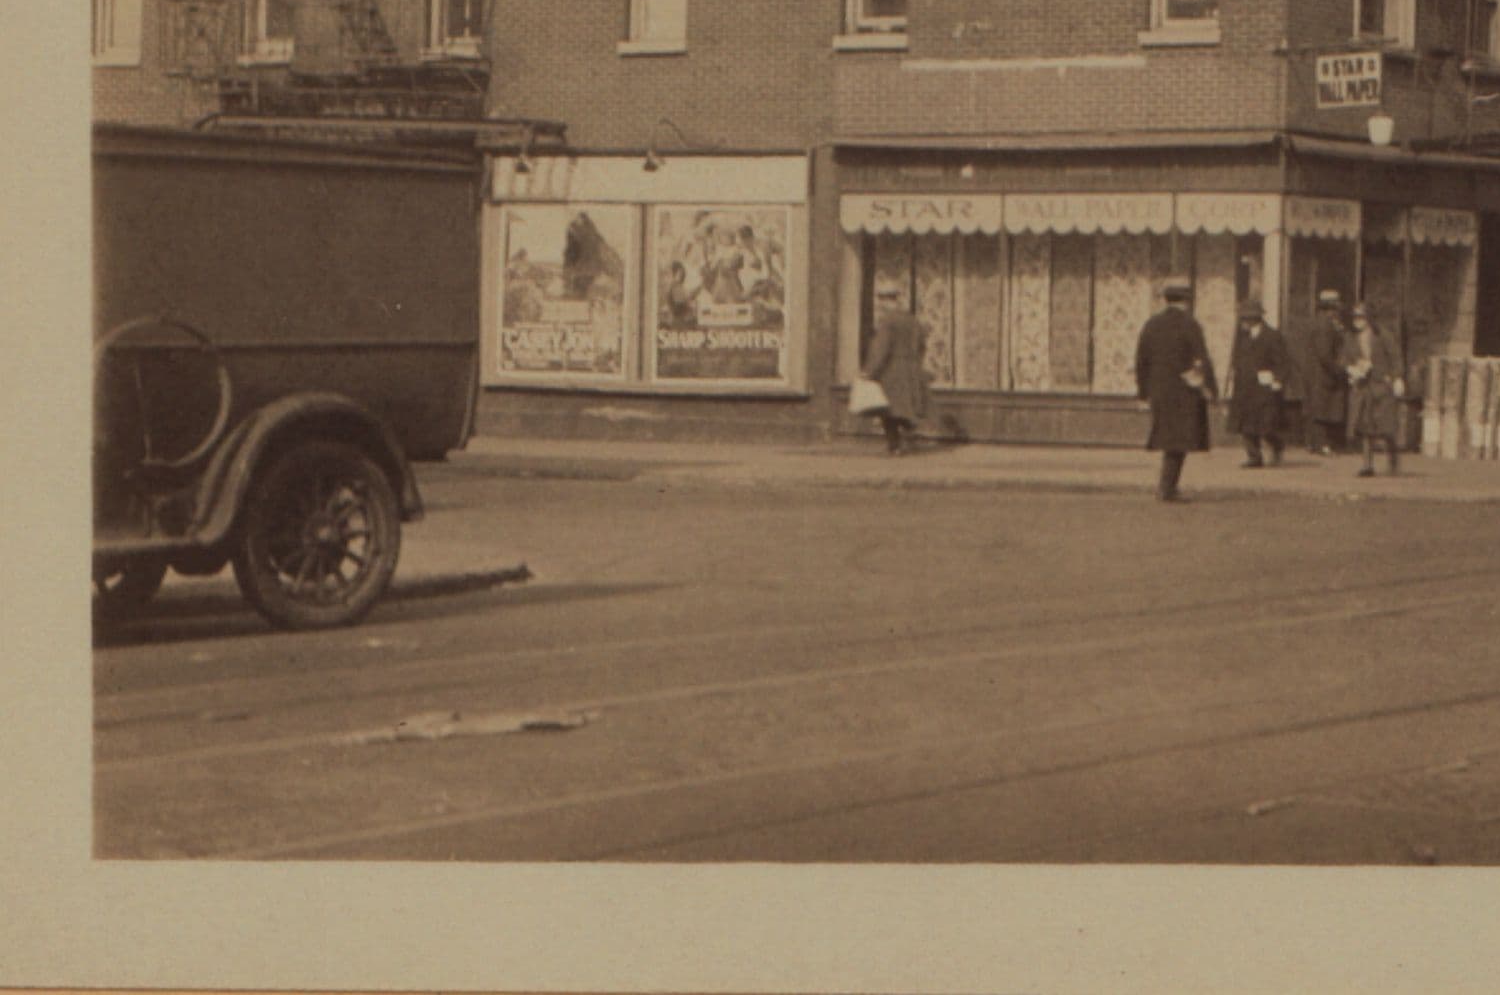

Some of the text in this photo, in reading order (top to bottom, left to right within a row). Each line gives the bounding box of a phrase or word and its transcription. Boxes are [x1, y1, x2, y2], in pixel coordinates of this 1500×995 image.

[1332, 56, 1365, 76] STAR
[1319, 76, 1380, 103] WALL PAPER
[869, 200, 974, 220] STAR
[1015, 199, 1069, 221] WALL
[1083, 199, 1161, 221] PAPER
